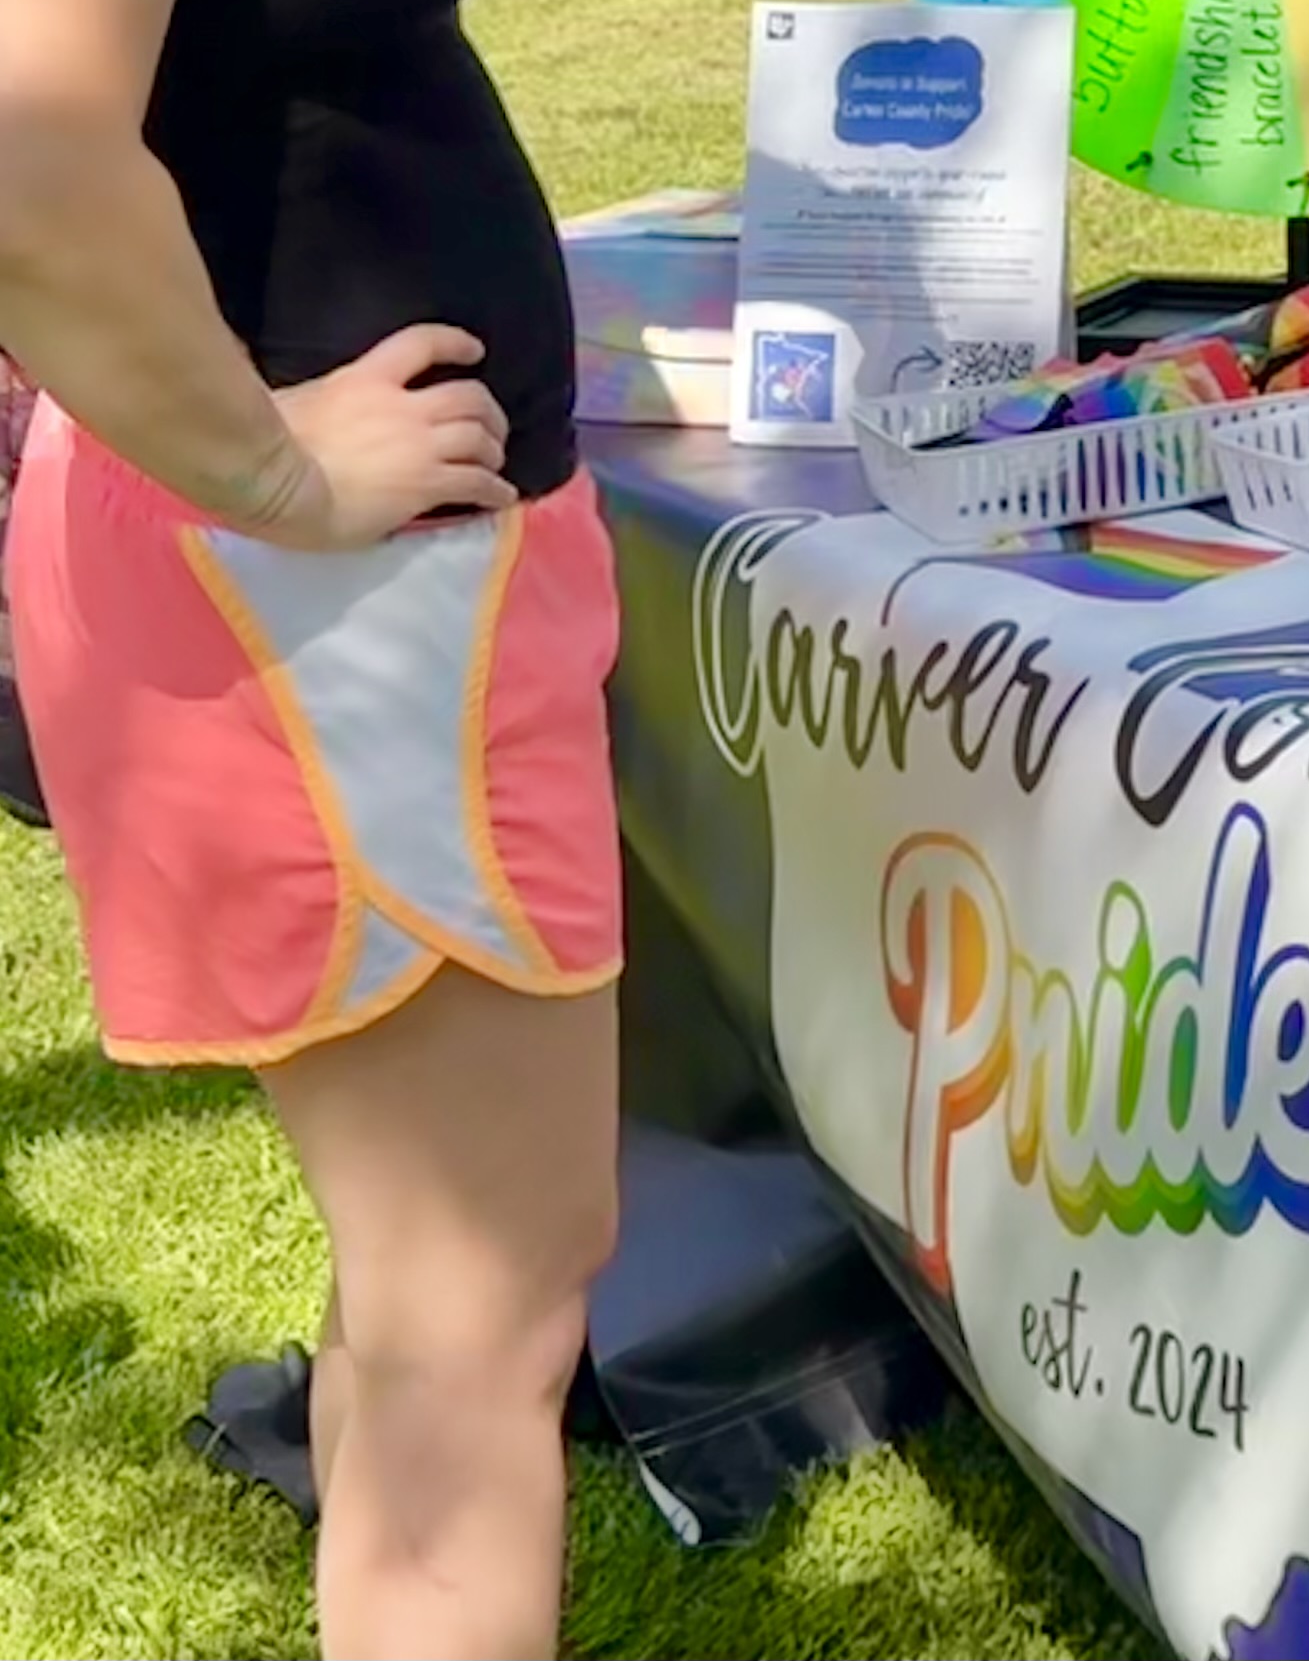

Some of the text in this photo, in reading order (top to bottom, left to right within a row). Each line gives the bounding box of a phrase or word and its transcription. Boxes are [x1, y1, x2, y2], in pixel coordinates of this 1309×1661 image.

[1241, 3, 1285, 146] bracelet
[693, 507, 1090, 794] Carver
[1020, 1268, 1248, 1452] est. 2024
